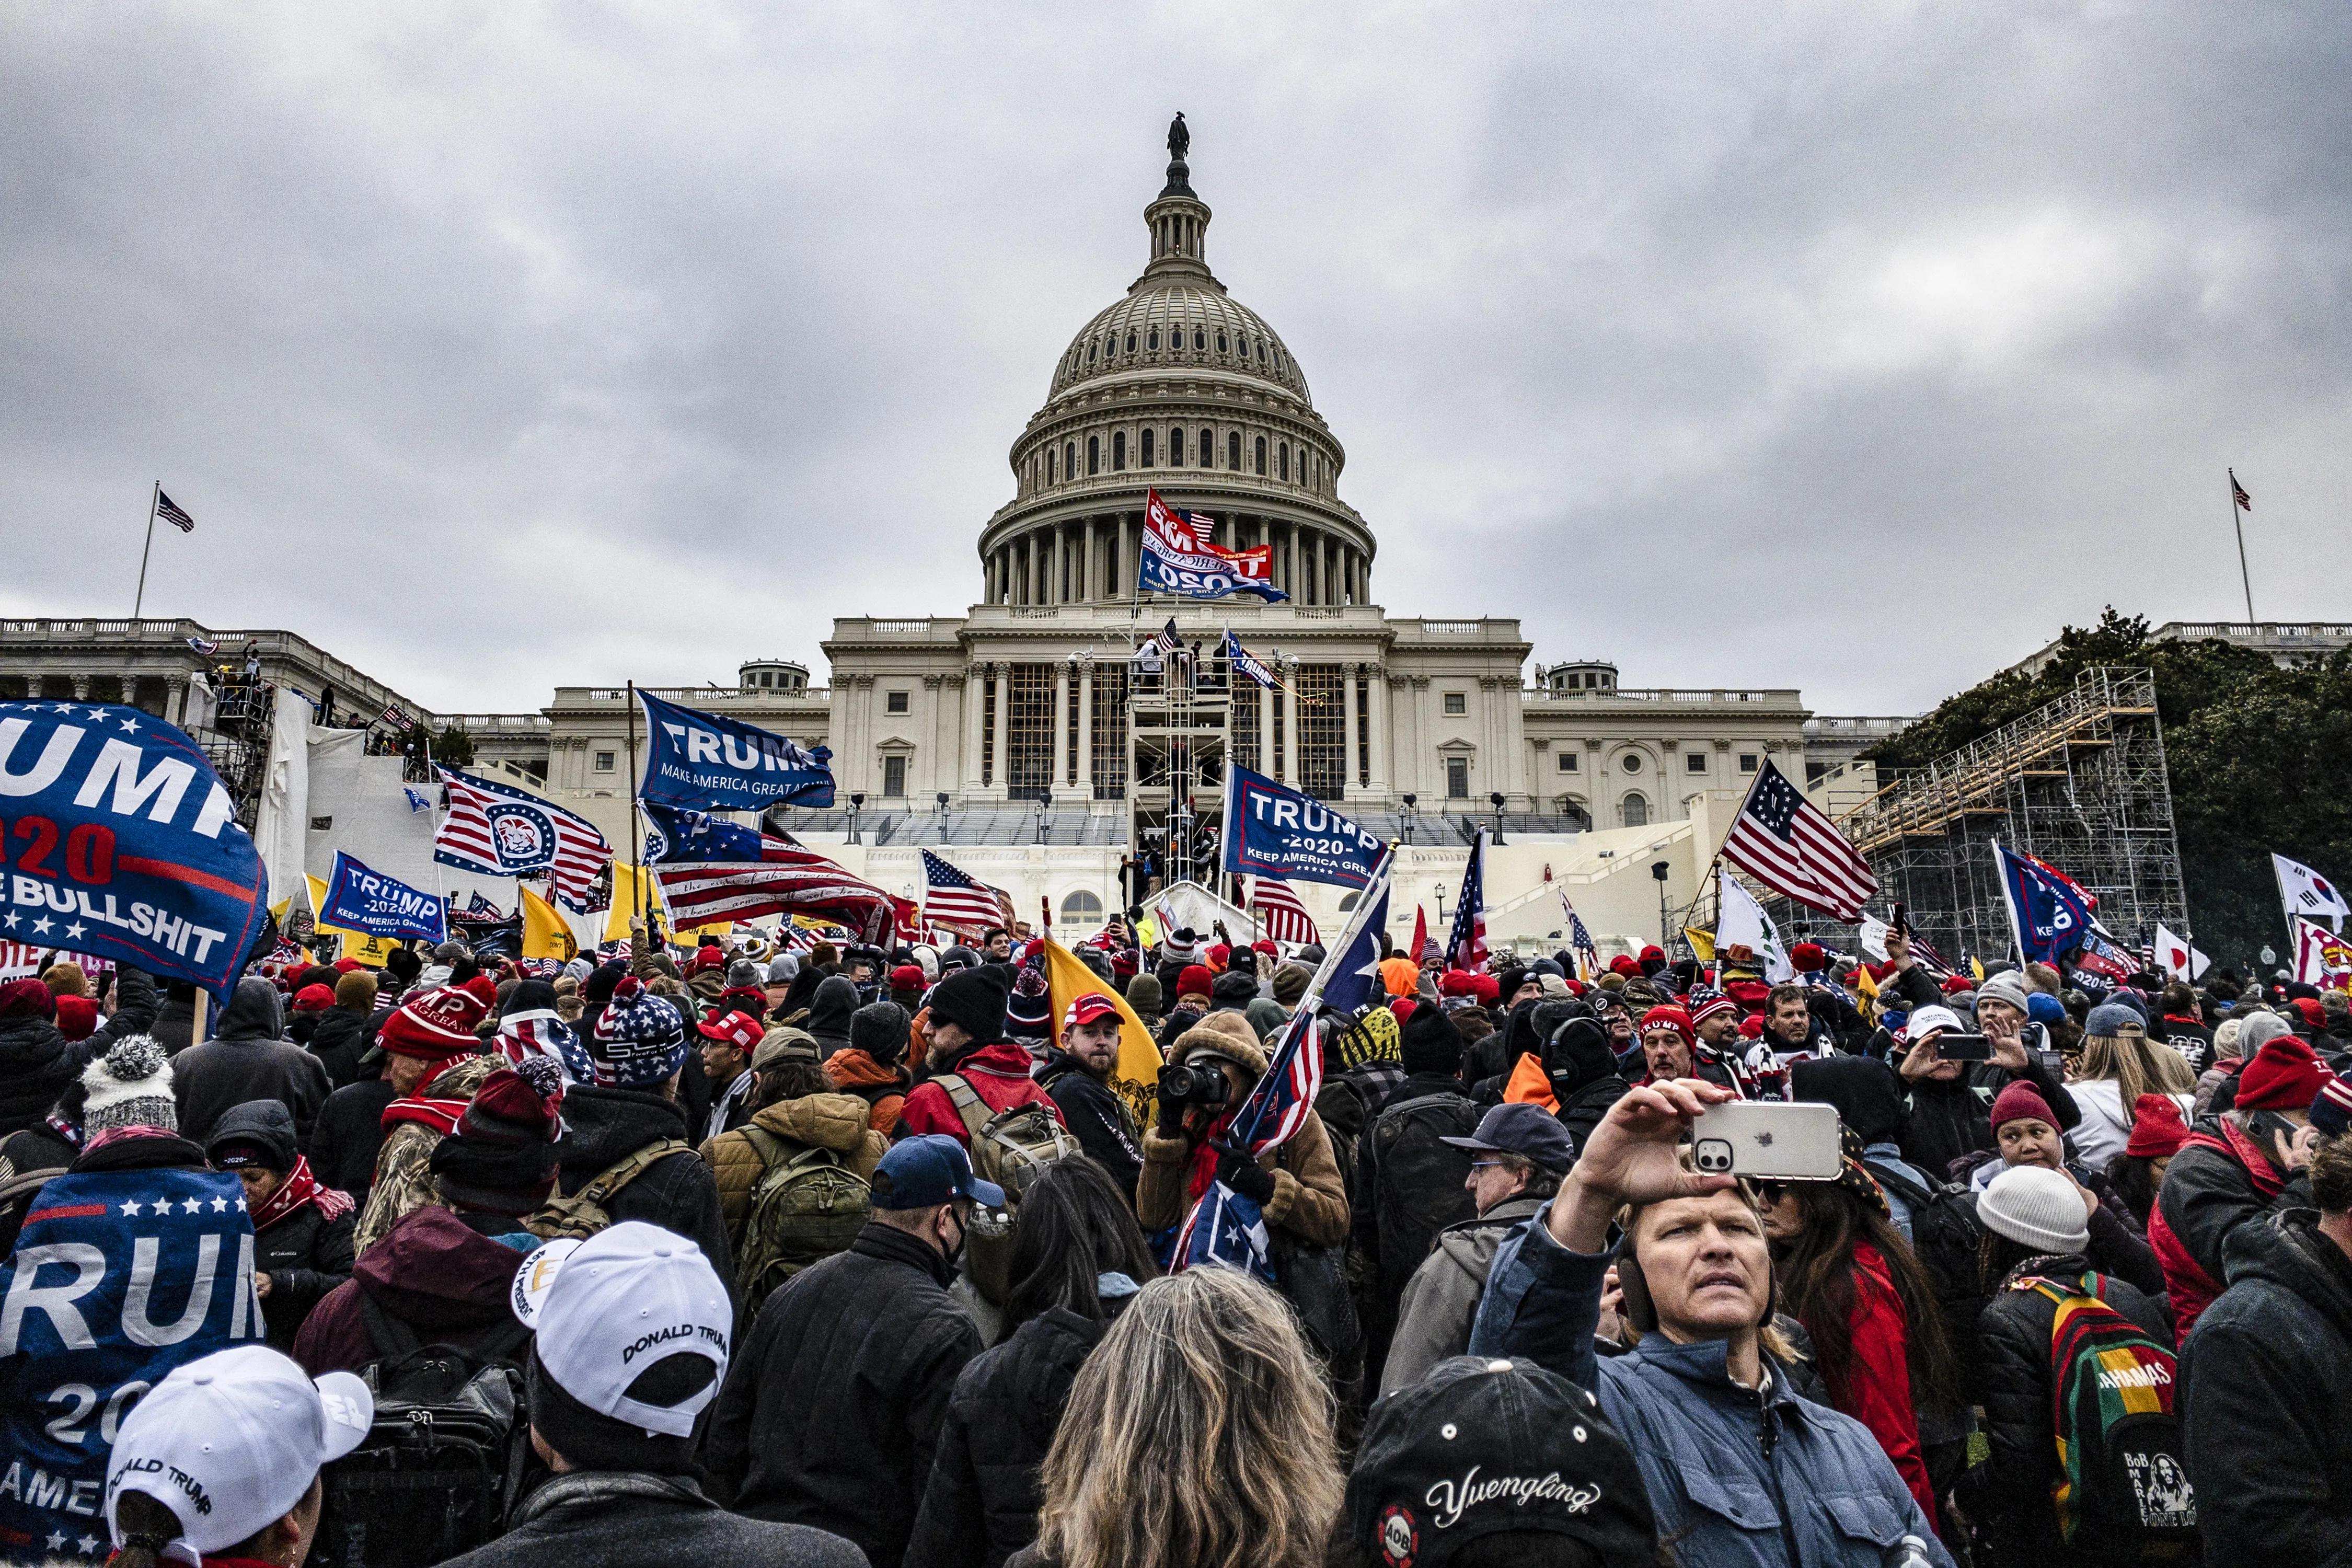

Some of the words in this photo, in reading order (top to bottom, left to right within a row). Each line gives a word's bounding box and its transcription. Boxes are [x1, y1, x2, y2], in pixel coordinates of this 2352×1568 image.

[661, 763, 690, 783] MAKE
[693, 774, 748, 792] AMERICA
[752, 782, 791, 795] GREAT
[1250, 791, 1379, 851] TRUMP
[1247, 847, 1279, 862] KEEP
[1282, 852, 1338, 868] AMERICA
[348, 867, 438, 920] TRUMP
[684, 881, 701, 892] the
[745, 872, 757, 885] of
[13, 874, 226, 964] BULLSHIT
[337, 907, 360, 920] KEEP
[361, 916, 400, 926] AMERICA
[690, 906, 718, 915] bear
[806, 891, 823, 900] not
[1640, 1021, 1679, 1035] TRUMP
[514, 1276, 534, 1319] PRESIDENT
[622, 1324, 694, 1365] DONALD
[2099, 1362, 2172, 1389] AHAMAS
[169, 1466, 212, 1516] TRUMP
[1426, 1464, 1601, 1529] Yuengling
[2149, 1511, 2178, 1527] ONE
